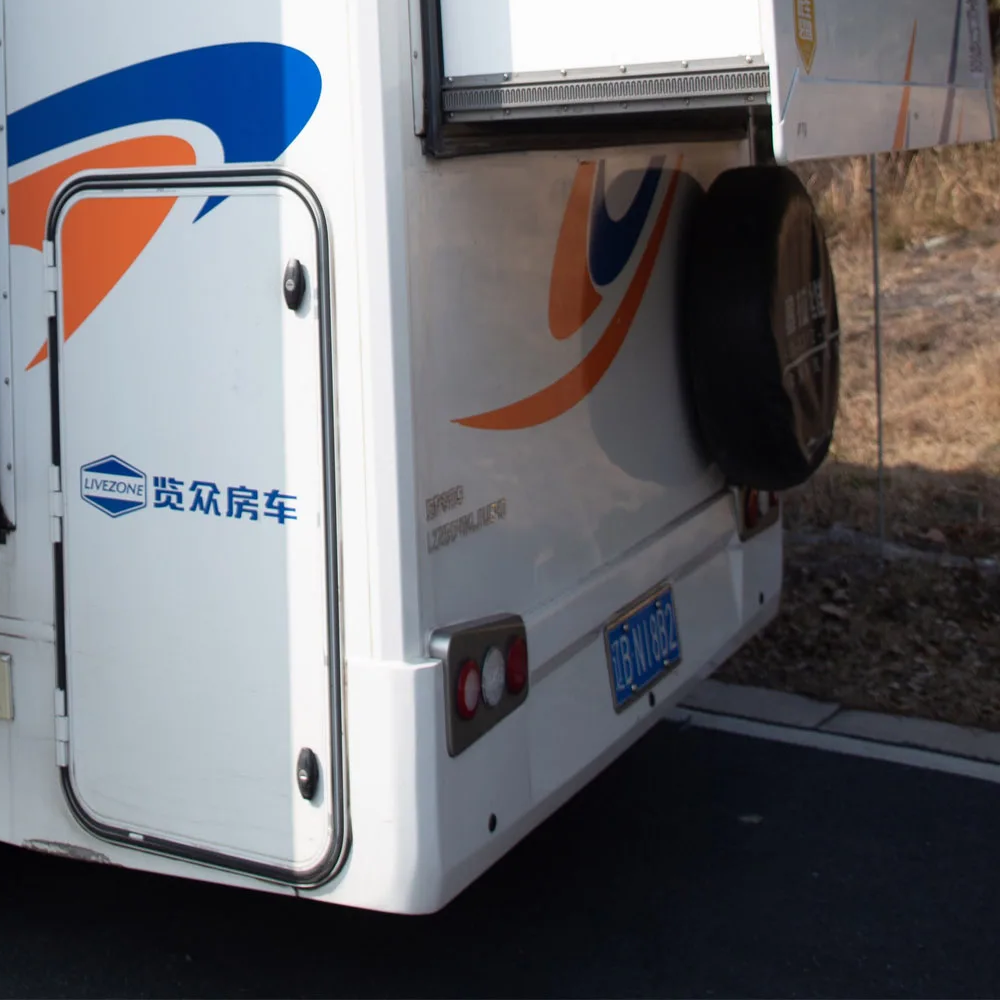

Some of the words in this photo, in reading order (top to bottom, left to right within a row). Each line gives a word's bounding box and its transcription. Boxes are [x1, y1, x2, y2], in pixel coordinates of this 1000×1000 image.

[84, 477, 144, 497] LIVEZONE
[152, 476, 298, 525] 览众房车
